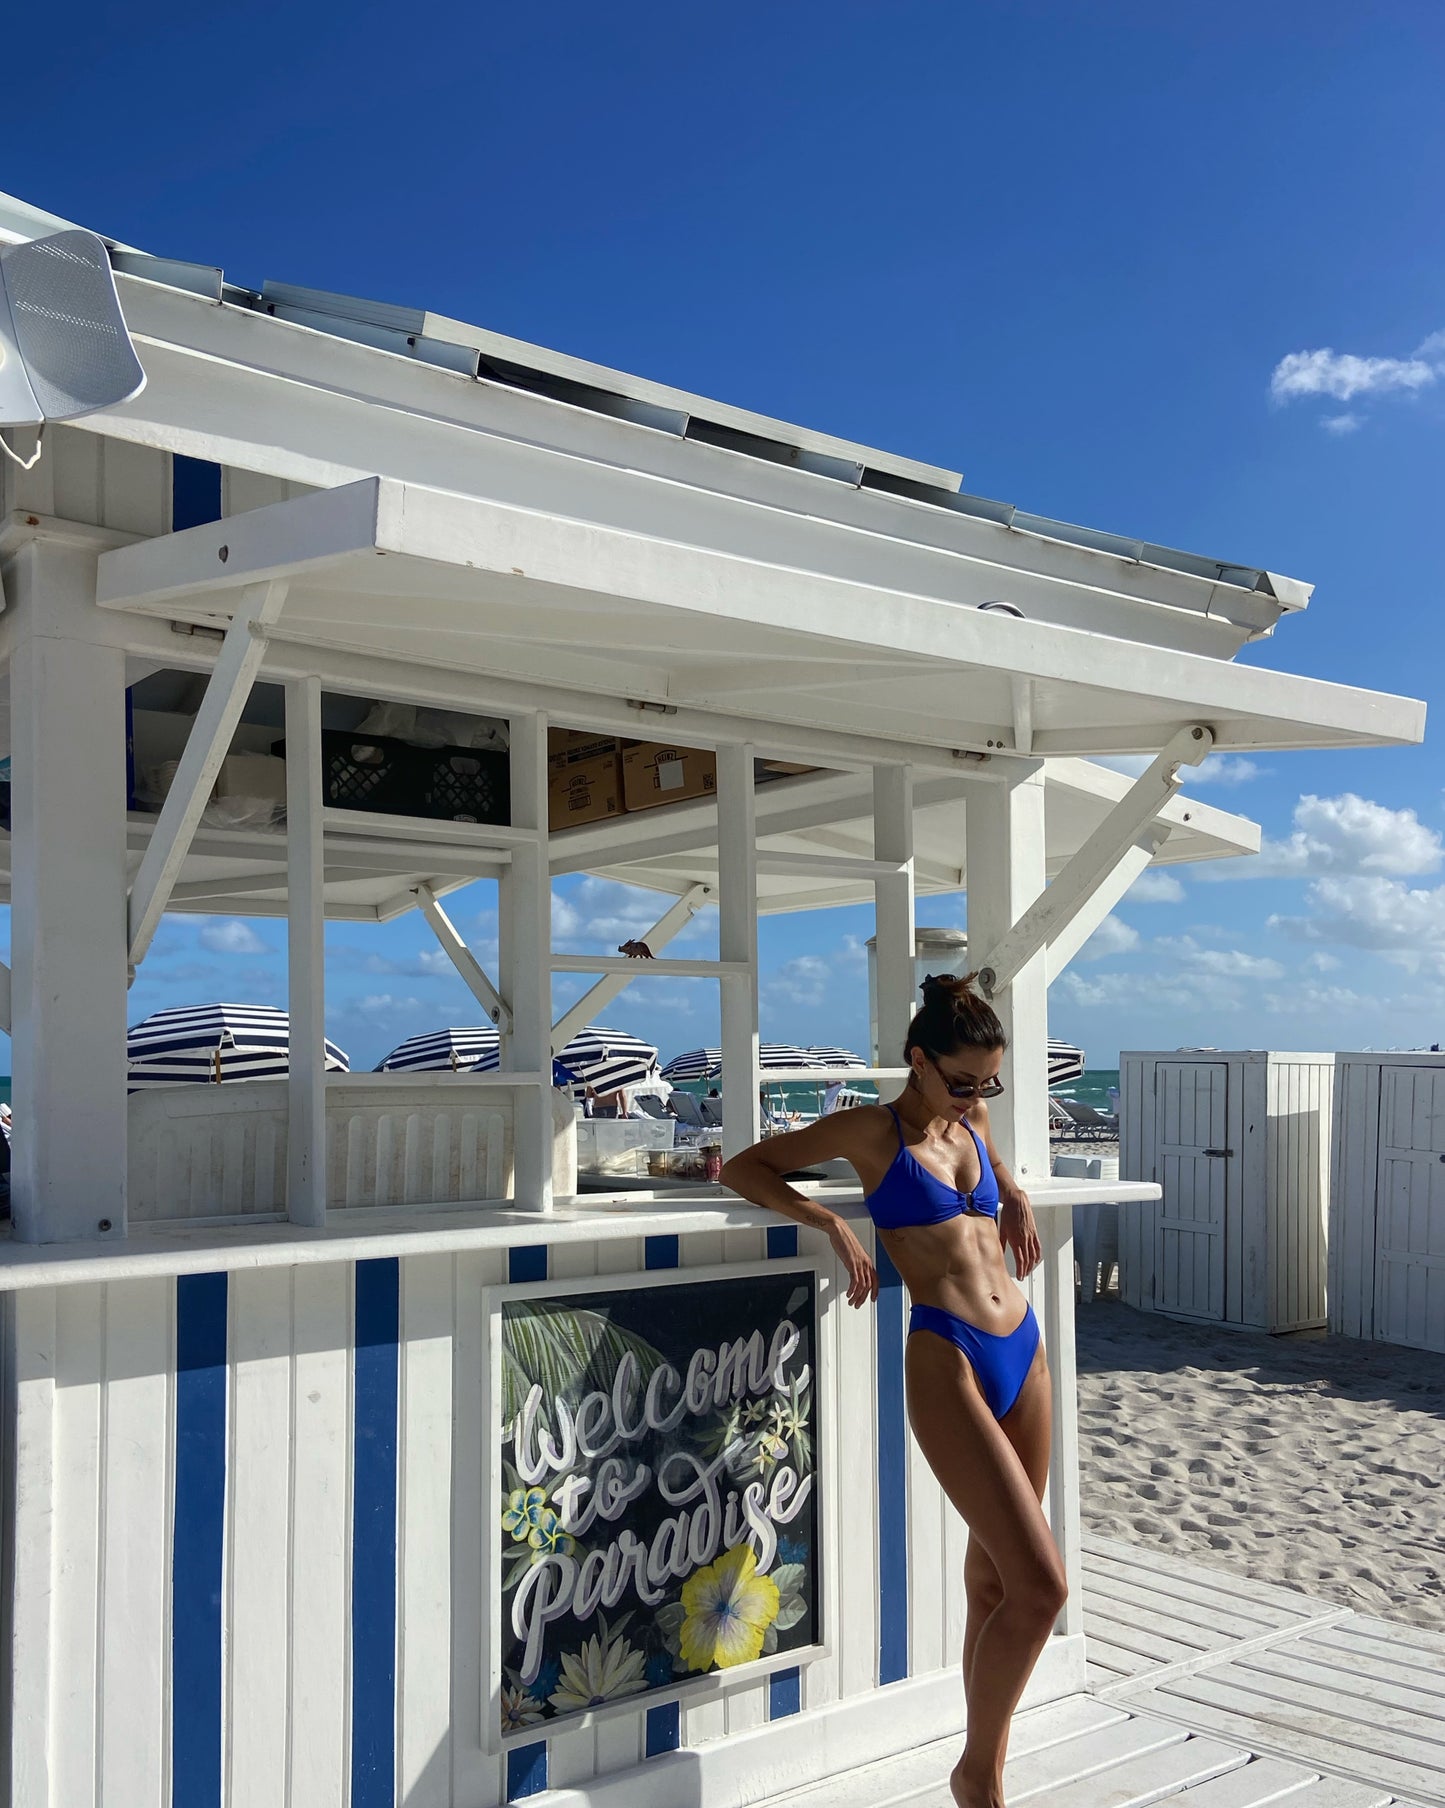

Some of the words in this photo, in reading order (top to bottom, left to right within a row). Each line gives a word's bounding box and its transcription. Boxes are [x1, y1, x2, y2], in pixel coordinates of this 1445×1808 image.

[657, 753, 674, 764] HEINZ
[501, 1319, 810, 1484] Welcome
[551, 1457, 651, 1538] to
